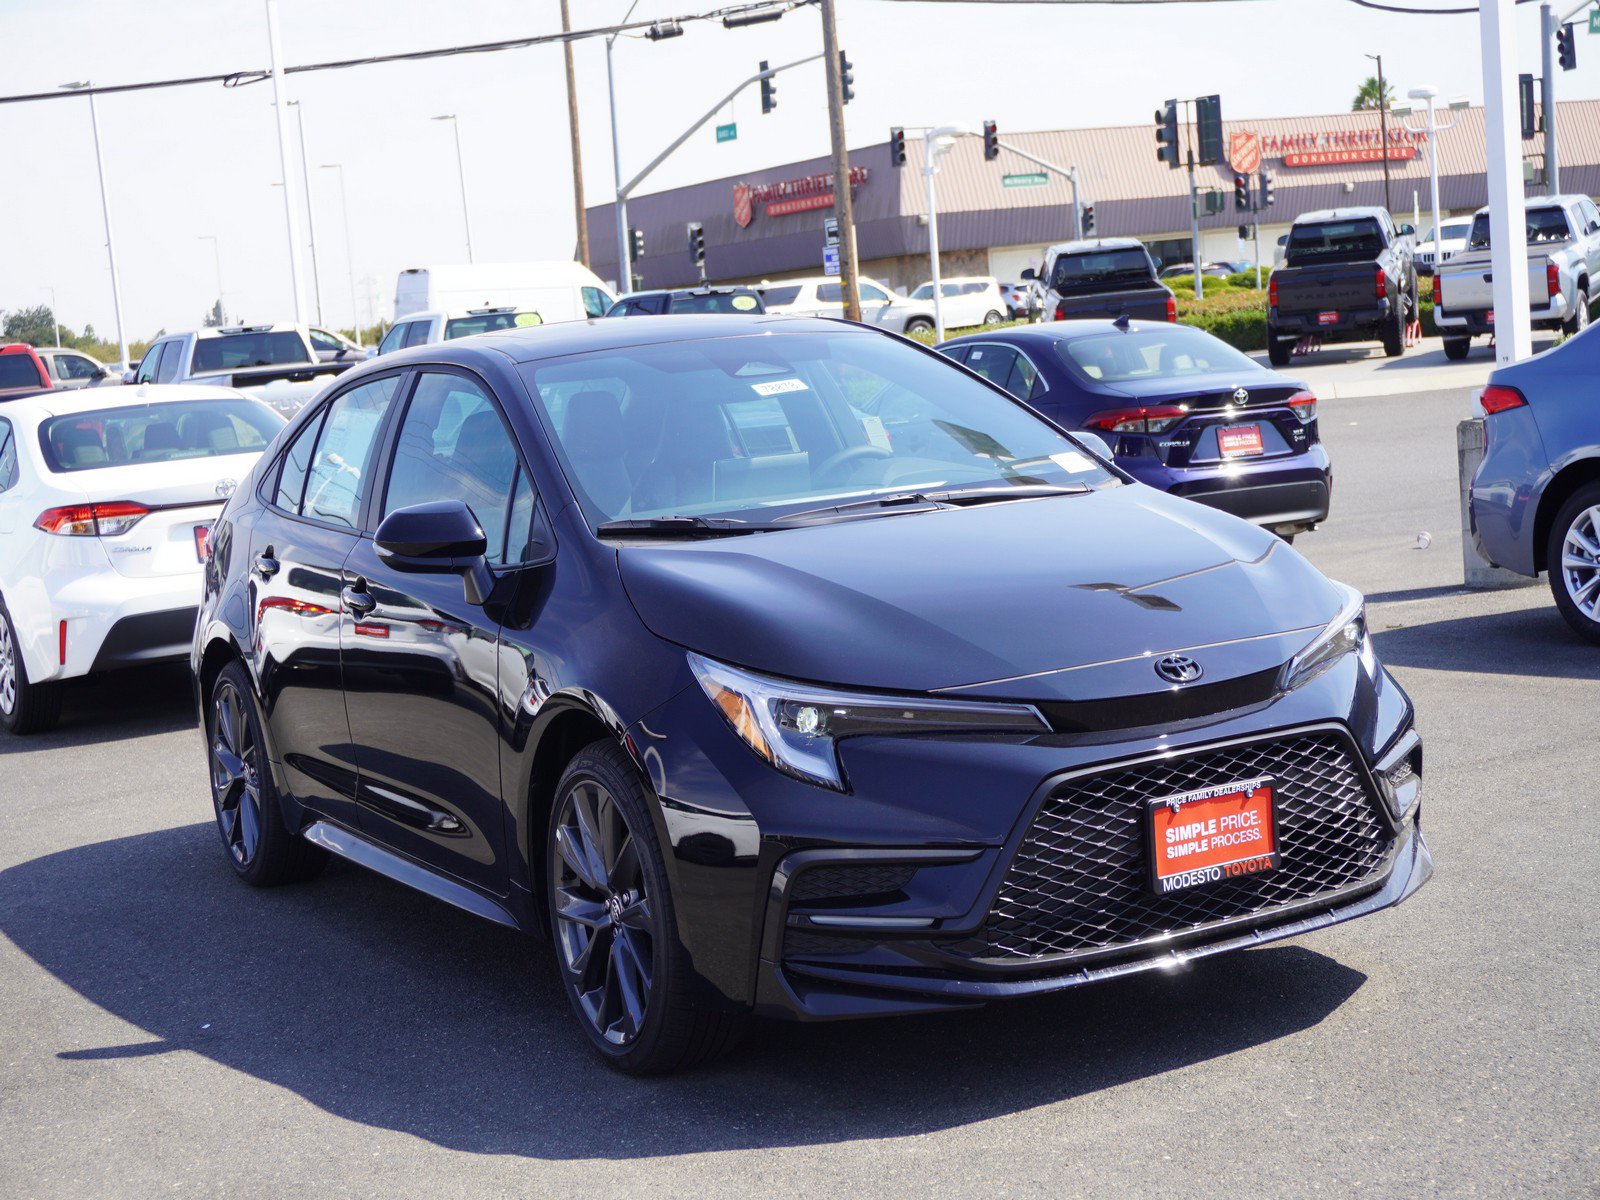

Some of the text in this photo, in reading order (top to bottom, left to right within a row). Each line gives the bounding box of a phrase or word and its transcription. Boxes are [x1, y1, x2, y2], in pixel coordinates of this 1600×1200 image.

[1261, 132, 1319, 153] FAMILY
[1323, 130, 1383, 147] THRIFT
[1293, 148, 1408, 164] DONATION CENTER
[1166, 781, 1261, 807] PRICE FAMILY DEALERSHIPS
[1165, 810, 1262, 843] SIMPLE PRICE.
[1167, 828, 1263, 859] SIMPLE PROCESS.
[1163, 857, 1273, 892] MODESTO TOYOTA
